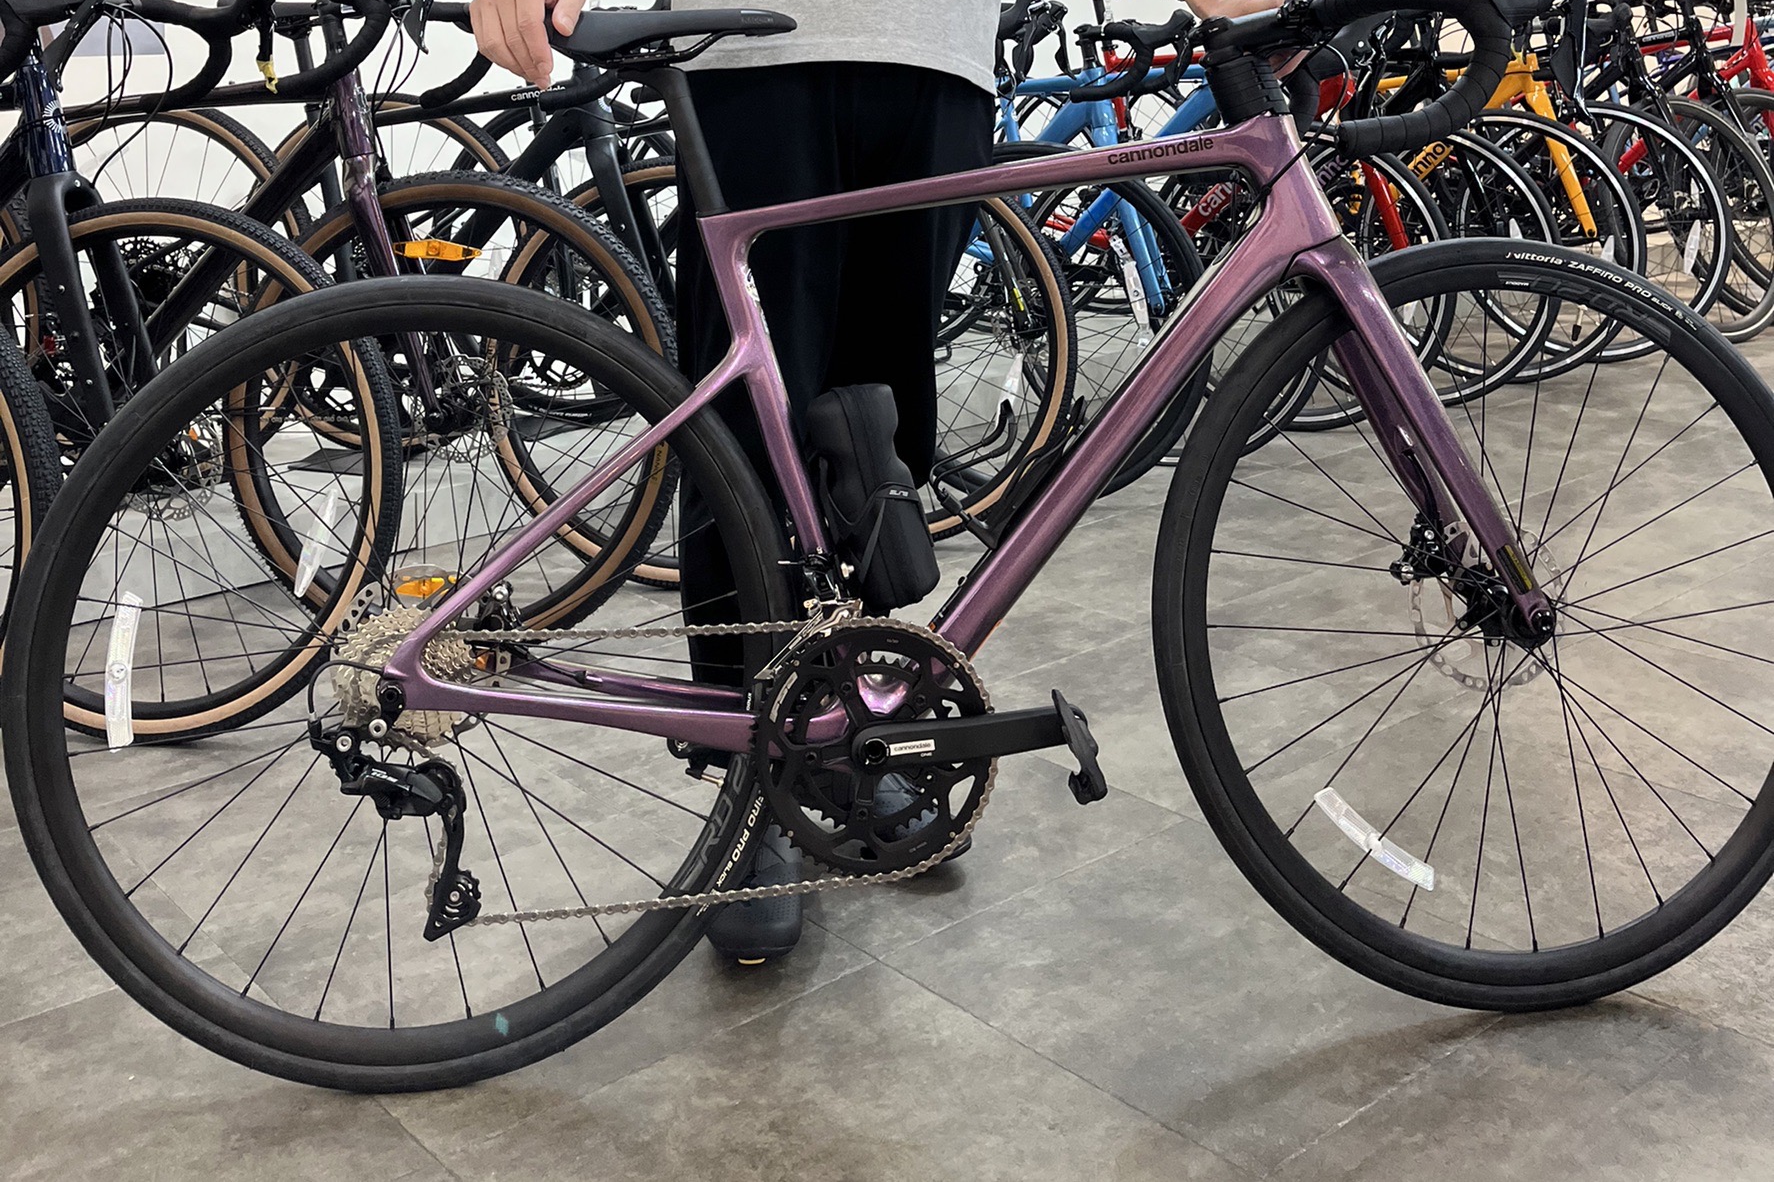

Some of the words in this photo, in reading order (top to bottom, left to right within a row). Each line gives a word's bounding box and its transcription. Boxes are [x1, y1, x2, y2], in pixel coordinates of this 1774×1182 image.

[1107, 136, 1214, 165] cannondale
[1513, 252, 1563, 266] vittoria
[1568, 260, 1623, 284] ZAFFIRO
[1624, 281, 1651, 299] PRO
[732, 828, 750, 862] PRO
